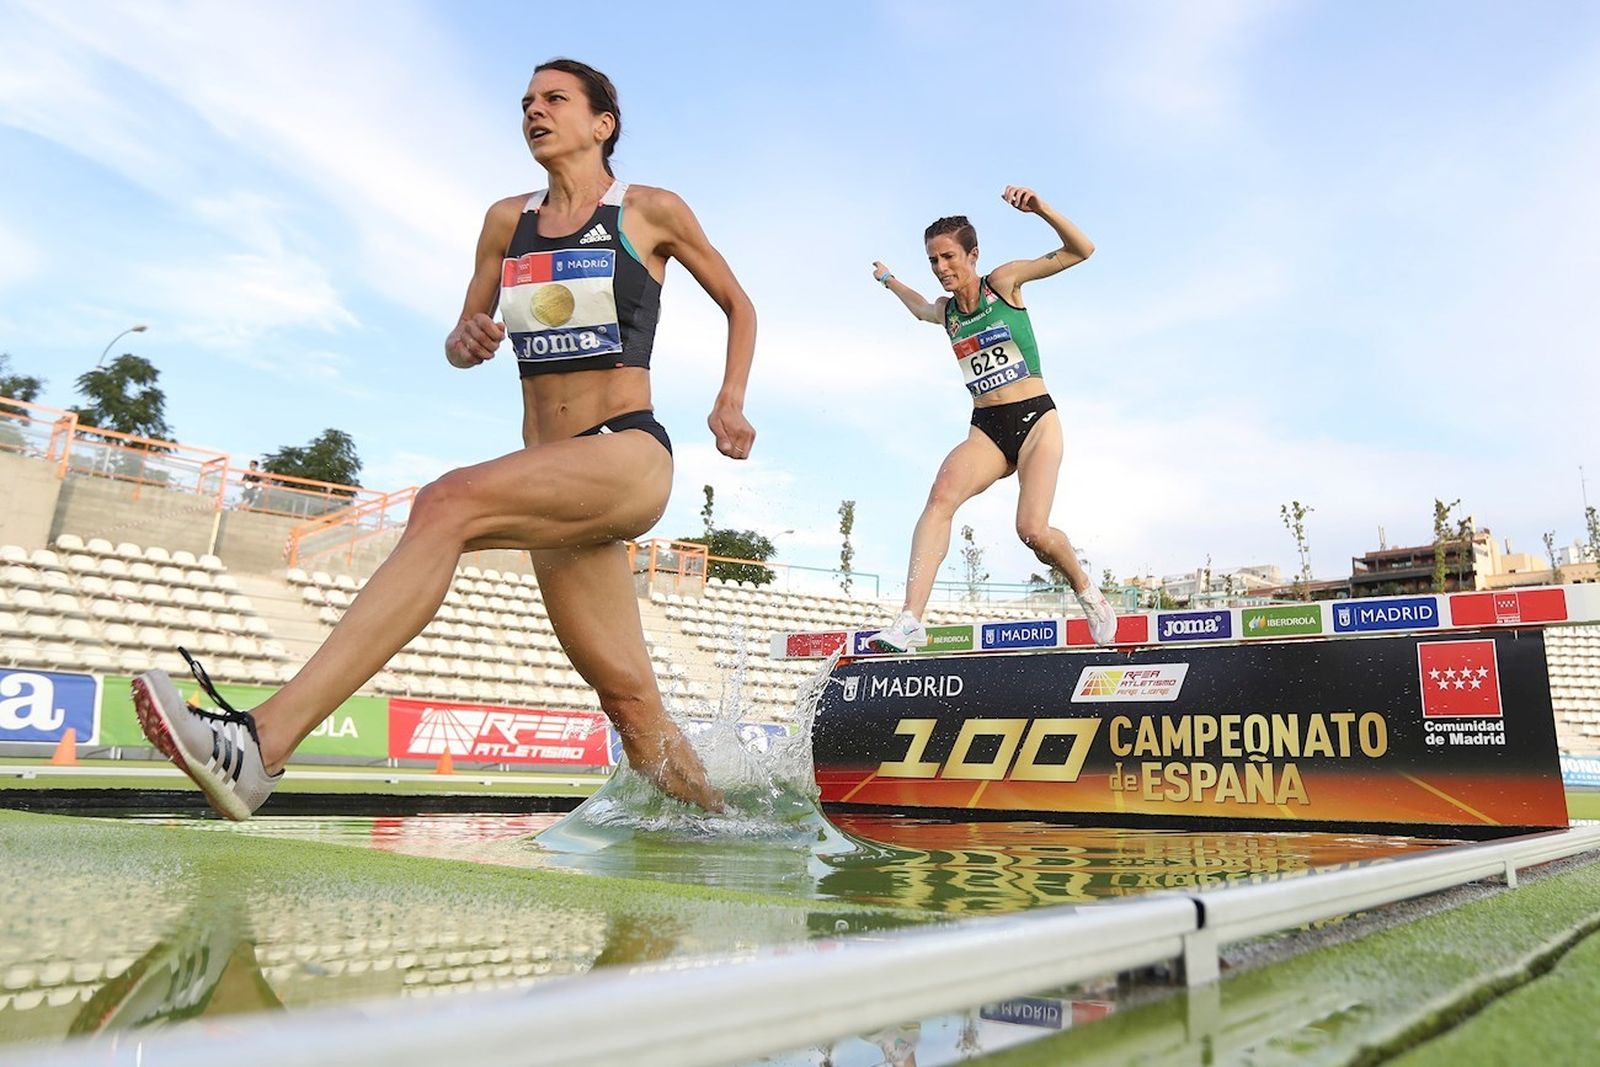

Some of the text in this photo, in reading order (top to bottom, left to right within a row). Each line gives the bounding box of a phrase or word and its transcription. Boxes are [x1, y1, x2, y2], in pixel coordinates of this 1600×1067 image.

[580, 234, 612, 244] adidas
[567, 257, 609, 269] MADRID
[970, 346, 1009, 376] 628
[1267, 616, 1316, 627] IBERDROLA
[1360, 605, 1433, 623] MADRID
[933, 635, 970, 644] IBERDROLA
[1001, 627, 1055, 642] MADRID
[1124, 670, 1161, 680] RFEA
[870, 675, 964, 698] MADRID
[1119, 679, 1177, 687] ATLETISMO
[480, 711, 594, 744] RFEA
[1424, 720, 1504, 732] Comunidad
[1109, 711, 1388, 758] CAMPEONATO
[1425, 732, 1506, 745] de Madrid
[474, 742, 585, 759] ATLETISMO
[876, 718, 1103, 783] 100
[1108, 754, 1311, 805] de ESPAÑA
